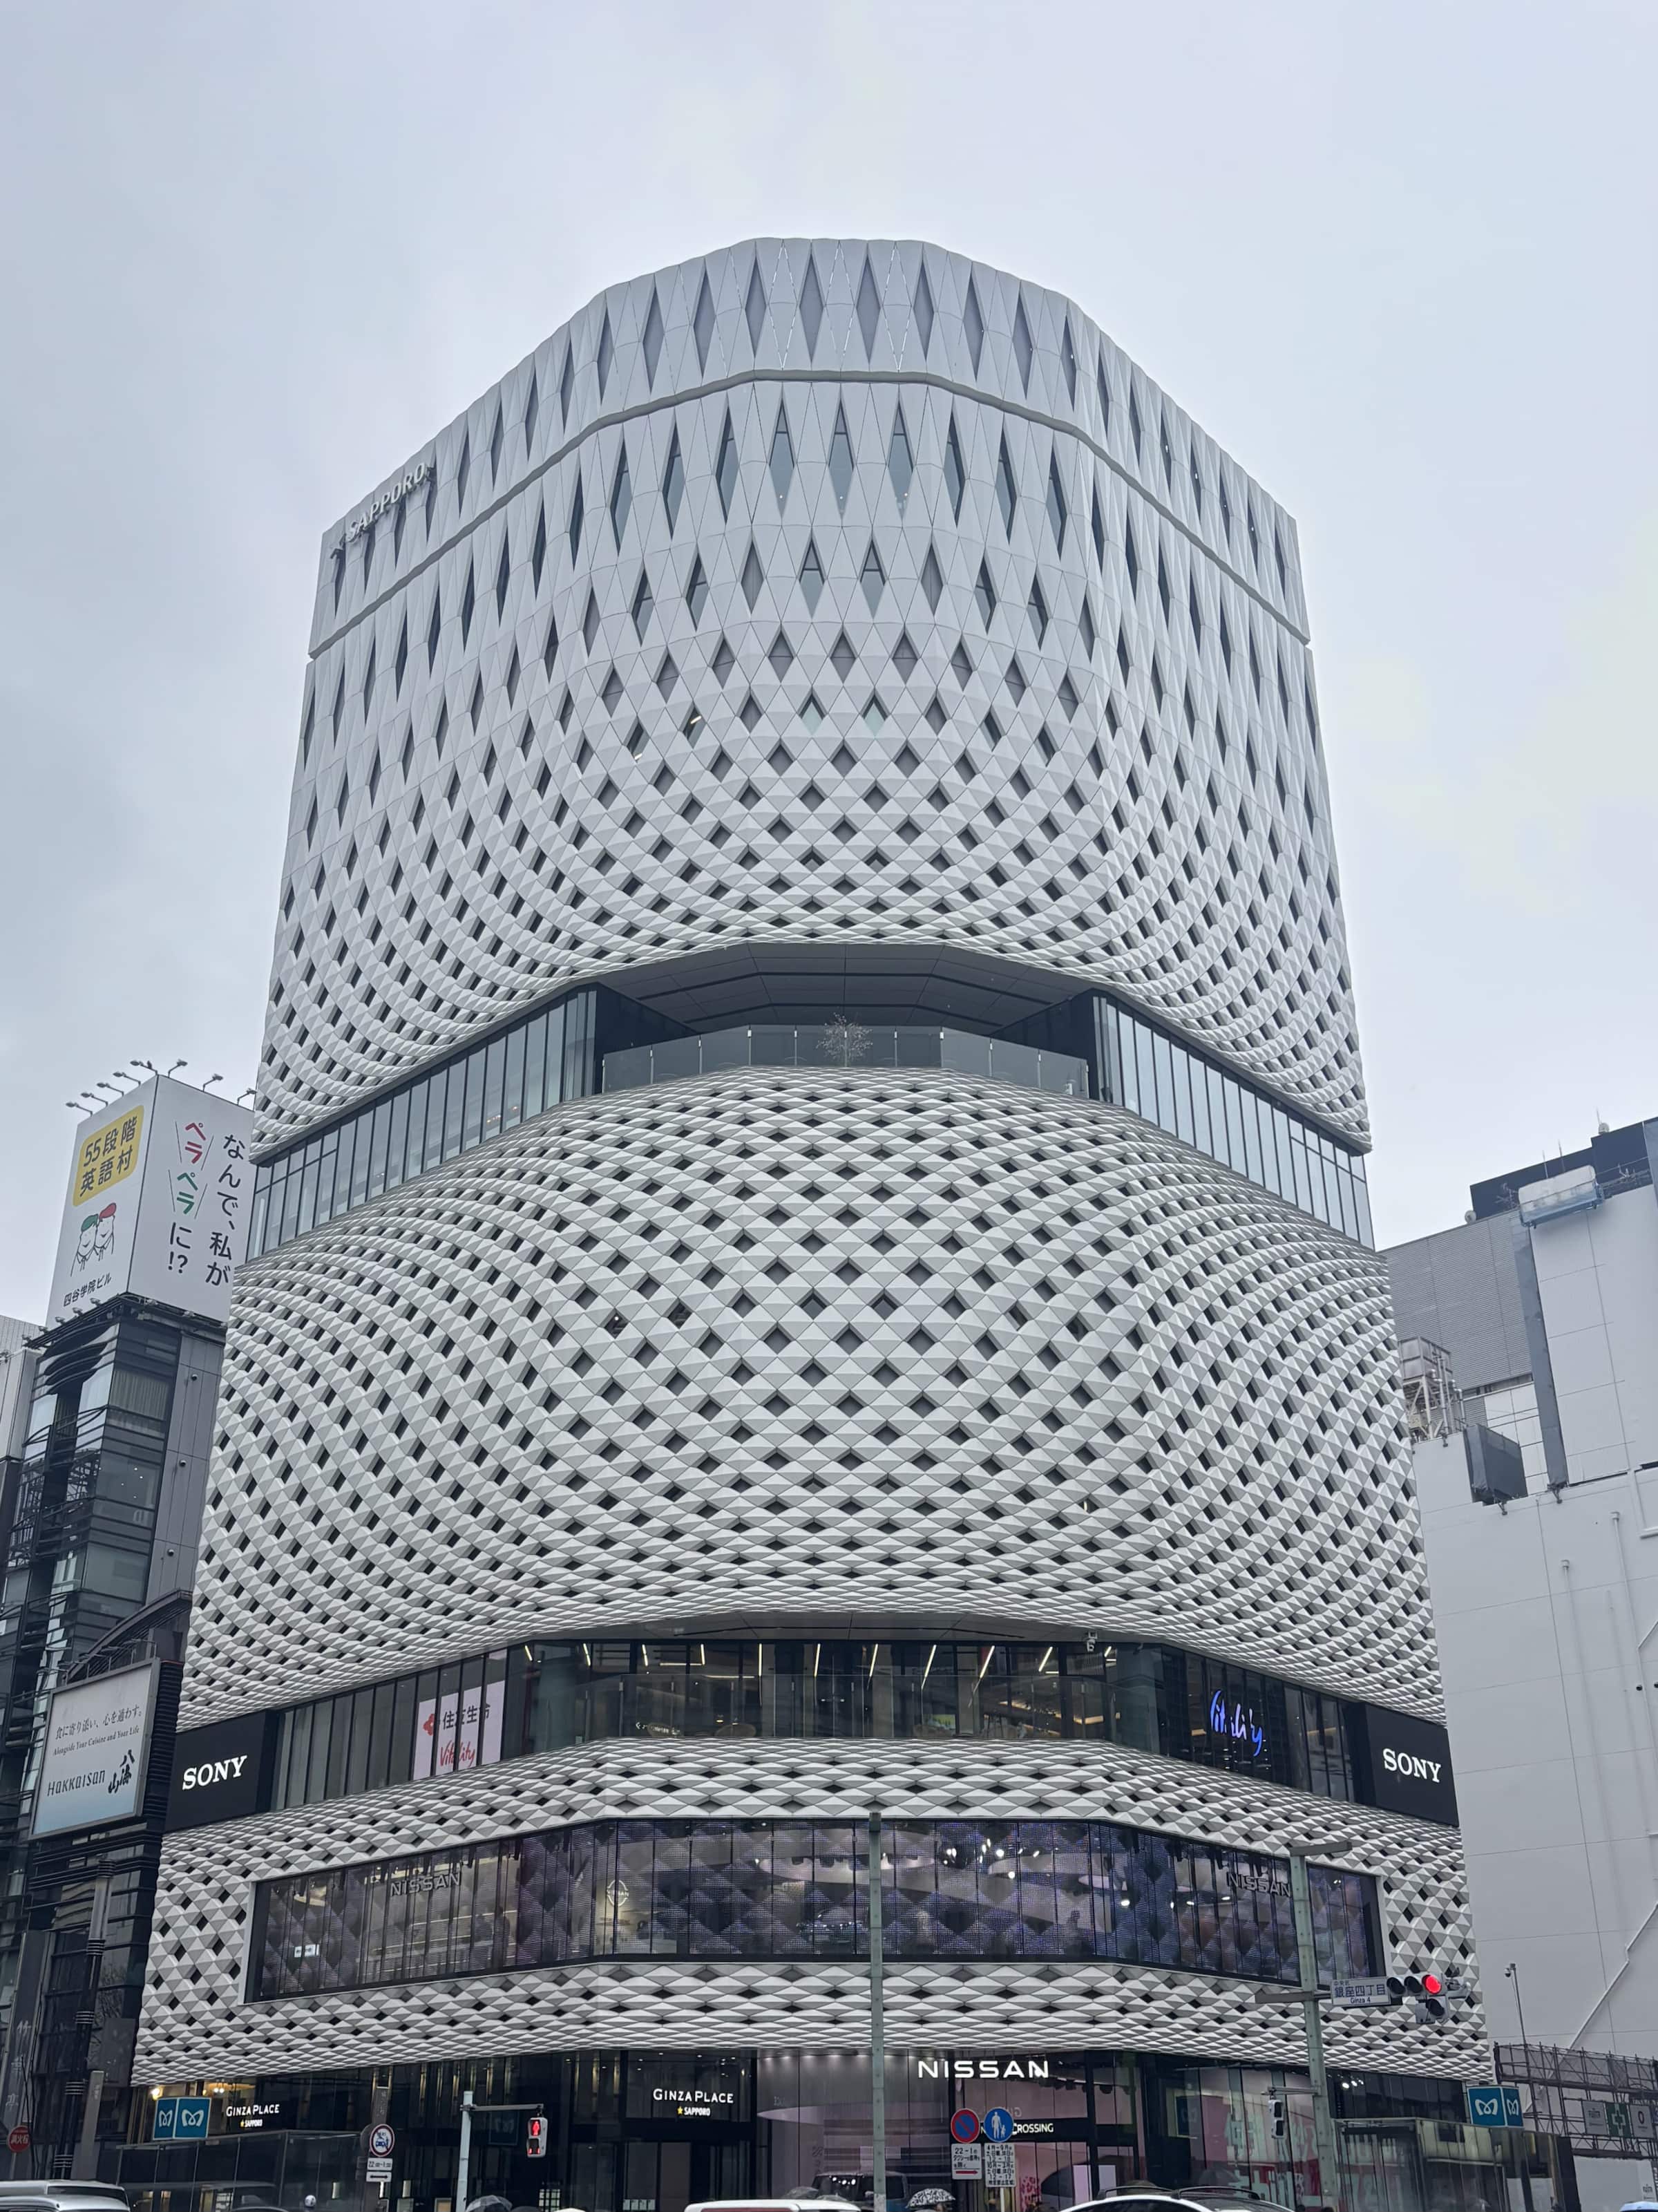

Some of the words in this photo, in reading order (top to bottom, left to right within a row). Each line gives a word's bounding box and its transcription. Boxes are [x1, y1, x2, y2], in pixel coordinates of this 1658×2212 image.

[346, 462, 426, 542] SAPPORO
[83, 1116, 137, 1166] 55段階
[80, 1146, 133, 1196] 英語村
[205, 1134, 245, 1286] なんで、私が
[64, 1273, 112, 1307] 四谷学院ビル
[106, 1731, 116, 1741] and
[129, 1725, 140, 1736] Life
[439, 1740, 476, 1767] Vitlity
[1382, 1748, 1441, 1783] SONY
[182, 1755, 247, 1790] SONY
[390, 1871, 462, 1897] NISSAN
[1226, 1871, 1290, 1897] NISSAN
[1335, 1984, 1386, 1998] 銀座四丁目
[918, 2060, 1049, 2079] NISSAN
[653, 2088, 692, 2102] GINZA
[695, 2090, 734, 2104] PLACE
[226, 2106, 251, 2117] GINZA
[253, 2104, 280, 2115] PLACE
[245, 2119, 263, 2127] SAPPORO
[684, 2106, 711, 2117] SAPPORO
